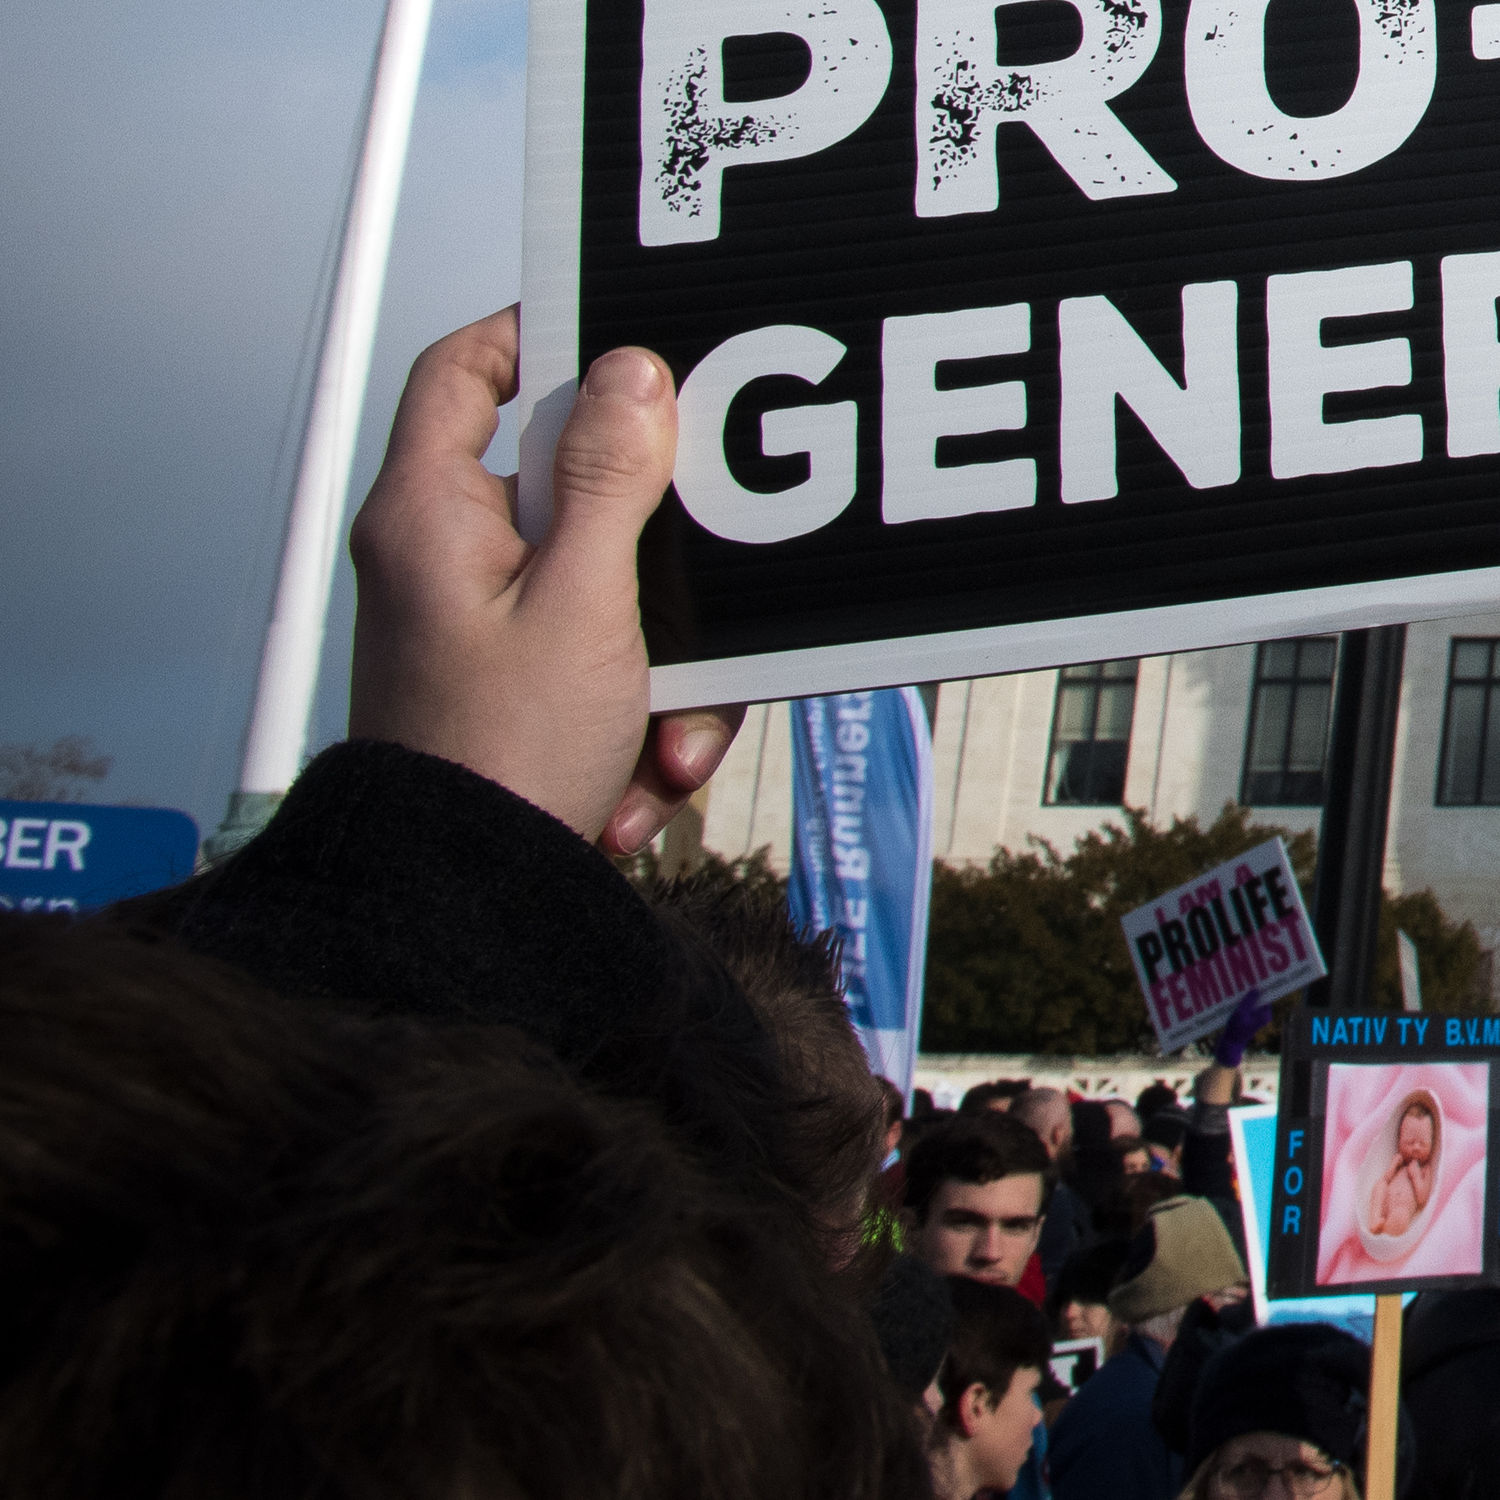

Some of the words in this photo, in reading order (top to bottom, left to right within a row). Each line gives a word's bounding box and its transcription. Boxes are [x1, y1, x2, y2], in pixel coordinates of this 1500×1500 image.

[0, 817, 92, 873] ER
[1178, 878, 1222, 914] AM
[1135, 865, 1295, 984] PROLIFE
[1150, 908, 1307, 1030] FEMINIST
[1281, 1130, 1305, 1236] FOR
